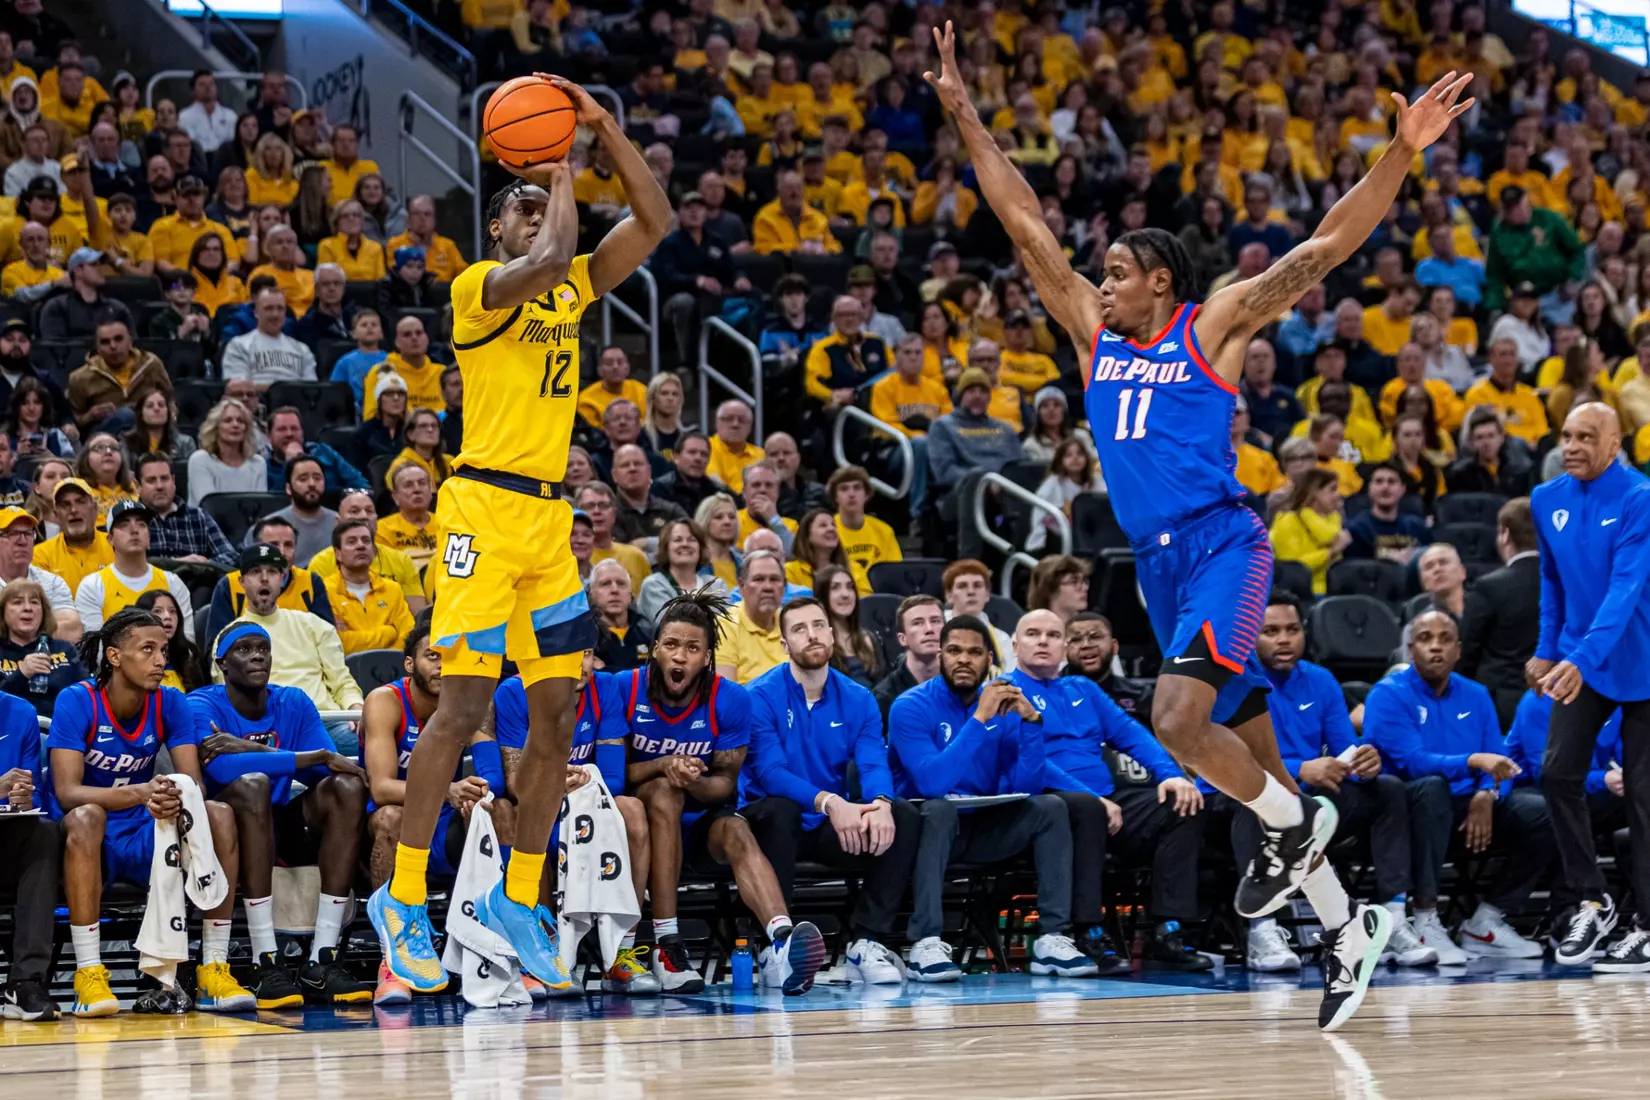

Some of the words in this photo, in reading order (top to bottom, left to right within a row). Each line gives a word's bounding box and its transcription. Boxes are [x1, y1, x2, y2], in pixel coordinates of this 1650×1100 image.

[539, 350, 573, 398] 12
[1114, 388, 1154, 441] 11
[443, 532, 481, 579] MU
